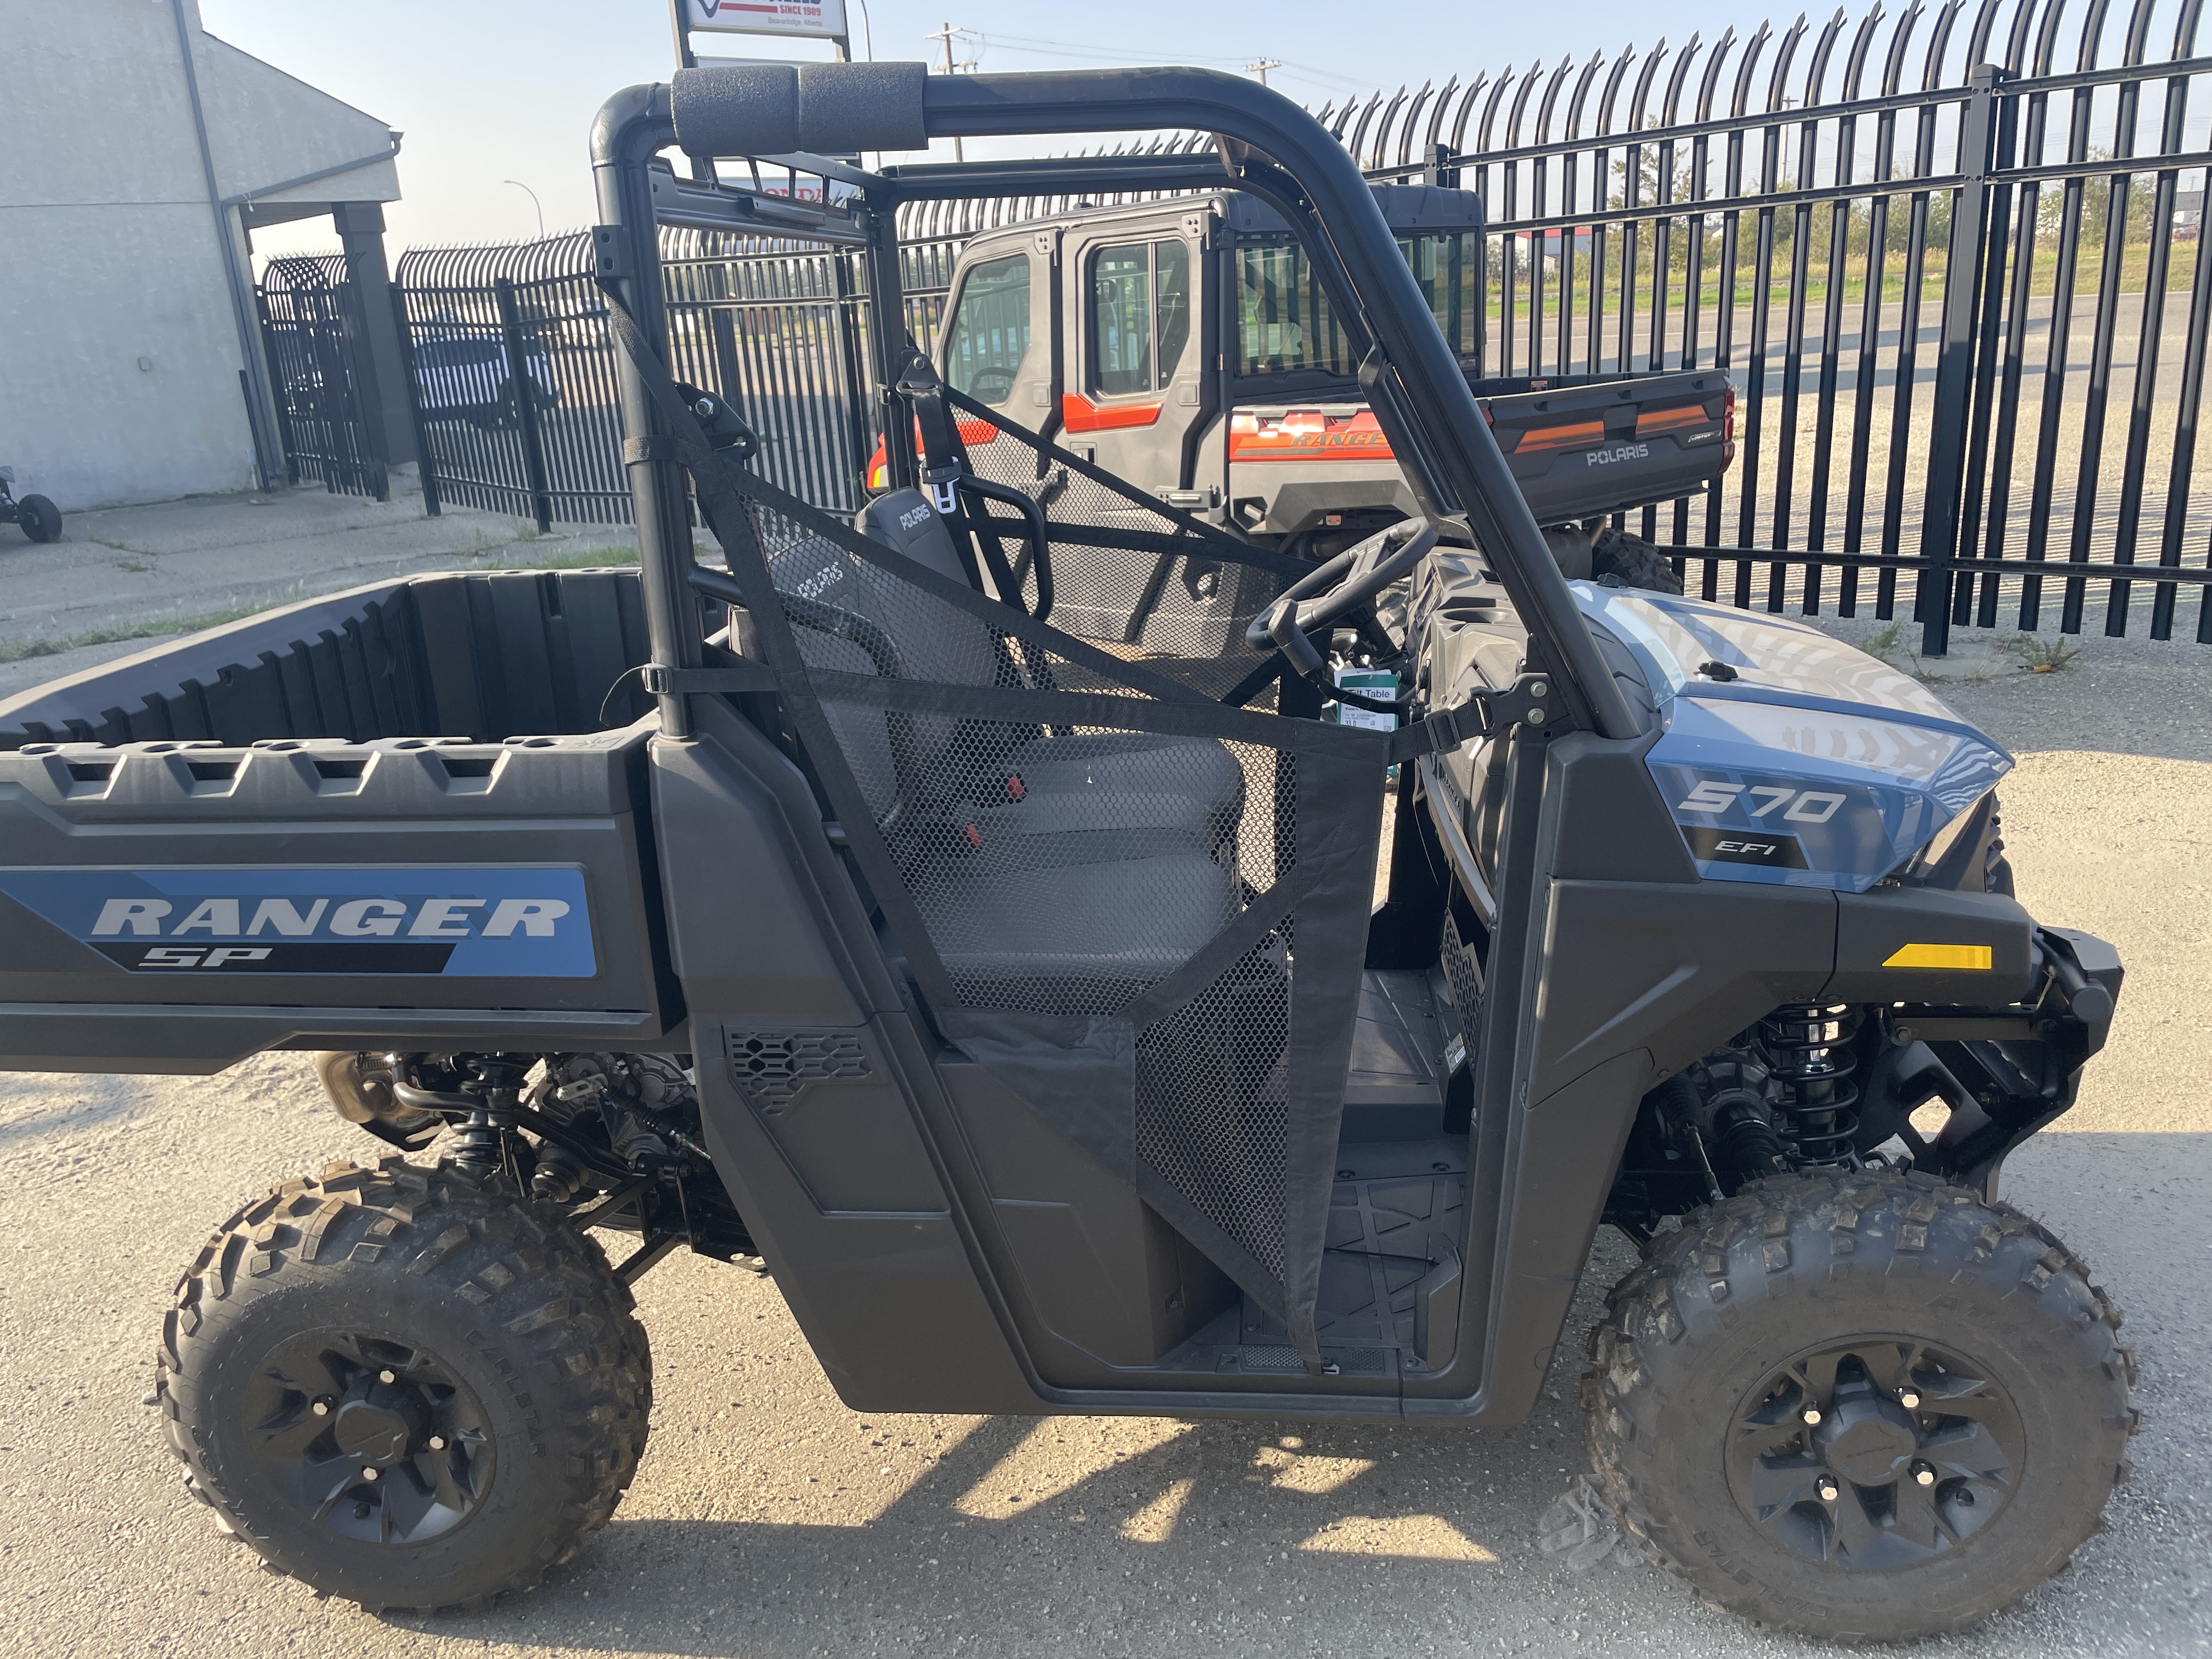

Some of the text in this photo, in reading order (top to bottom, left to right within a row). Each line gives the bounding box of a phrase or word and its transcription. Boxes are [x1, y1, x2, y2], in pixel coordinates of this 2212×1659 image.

[780, 5, 821, 15] SINCE 1909
[1291, 433, 1388, 447] RANGE
[1587, 444, 1649, 466] POLARIS
[899, 504, 930, 531] POLARIS
[1365, 690, 1389, 698] Table
[1678, 780, 1847, 823] 570
[1715, 840, 1776, 855] EFI
[91, 899, 570, 936] RANGER
[138, 947, 273, 967] SP
